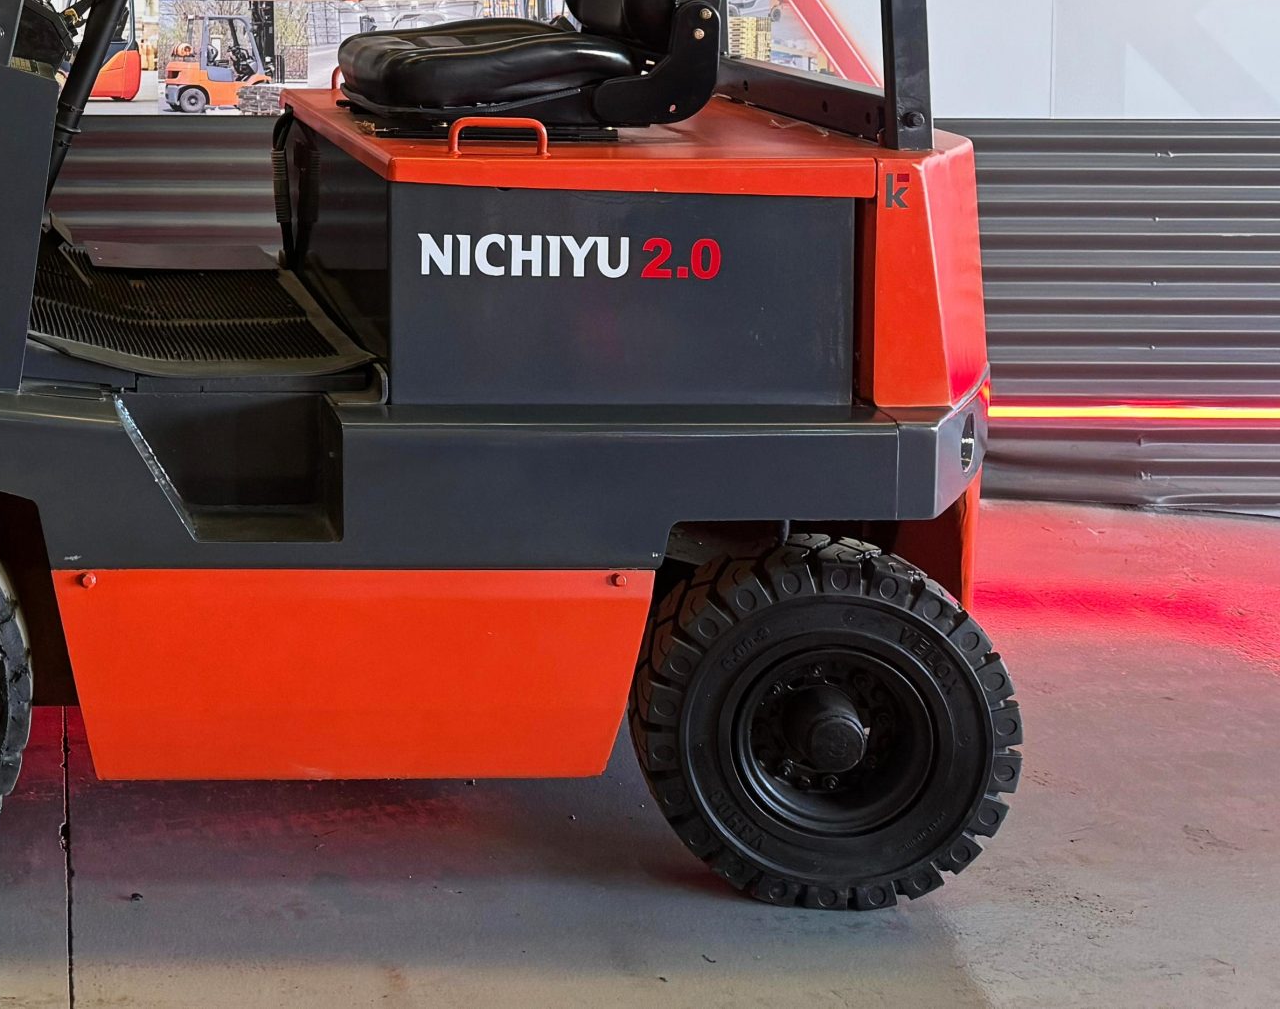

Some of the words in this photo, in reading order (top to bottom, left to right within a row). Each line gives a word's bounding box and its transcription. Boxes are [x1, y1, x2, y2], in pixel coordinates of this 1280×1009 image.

[418, 233, 629, 278] NICHIYU
[641, 237, 721, 280] 2.0
[899, 625, 958, 695] VELOX
